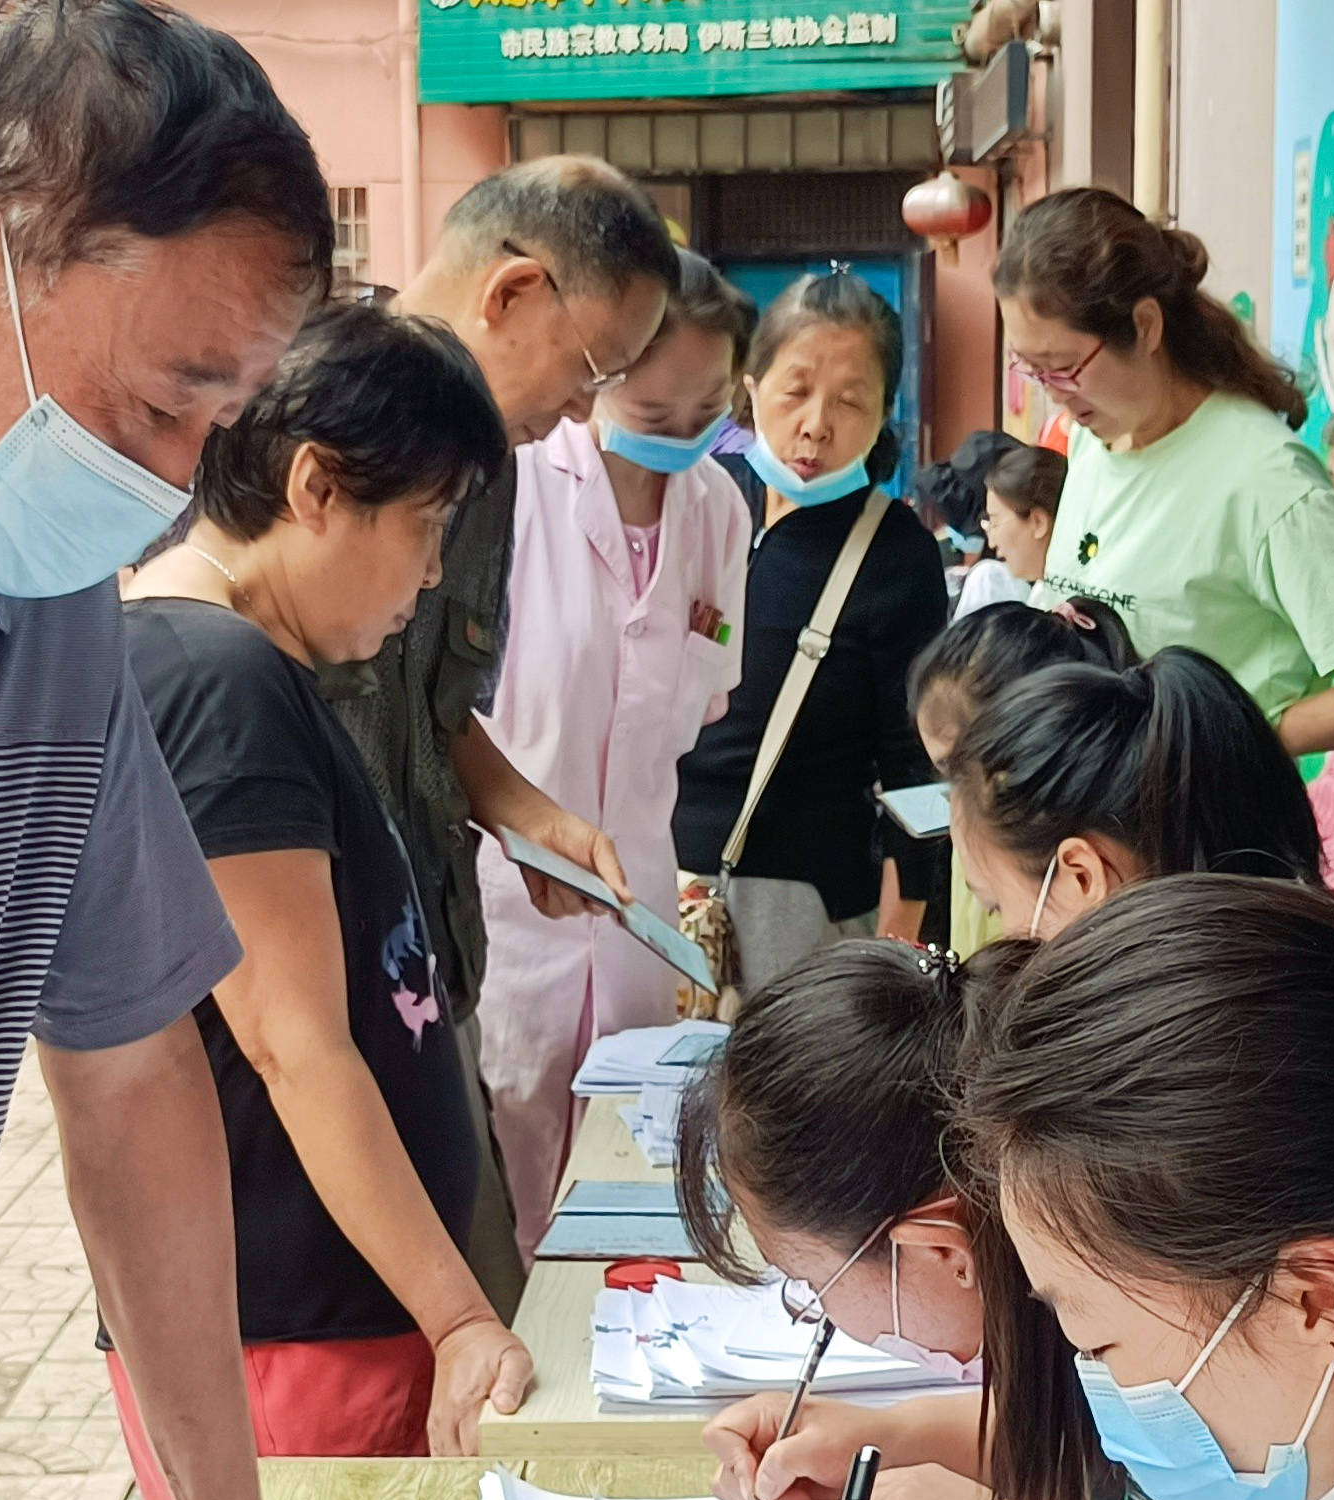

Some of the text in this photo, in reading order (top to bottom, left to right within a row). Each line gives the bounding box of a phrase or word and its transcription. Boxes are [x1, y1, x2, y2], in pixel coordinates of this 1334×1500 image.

[500, 12, 897, 60] 市民族宗教事务局 伊斯兰教协会监制
